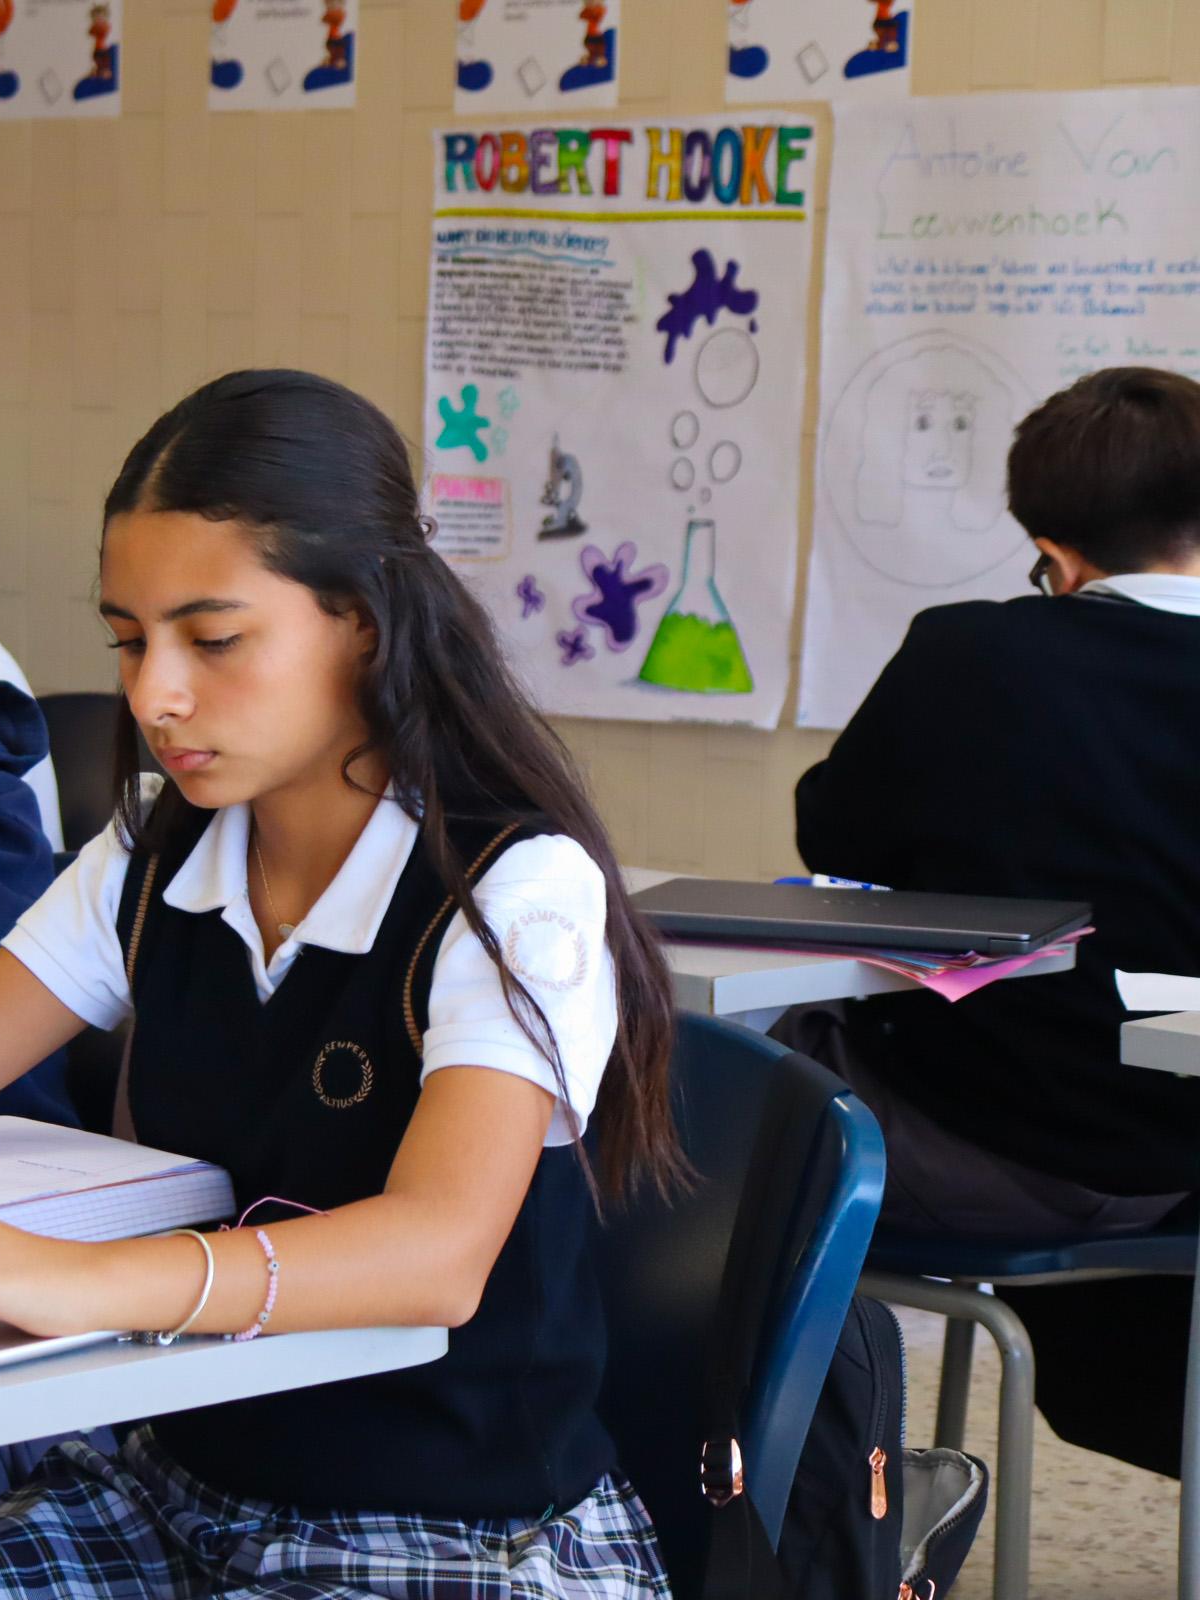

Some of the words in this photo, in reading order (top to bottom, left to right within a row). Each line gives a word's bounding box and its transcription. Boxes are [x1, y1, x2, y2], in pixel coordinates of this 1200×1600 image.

[443, 128, 633, 196] ROBERT
[646, 125, 813, 206] HOOKE
[1057, 113, 1180, 179] Van
[325, 1040, 367, 1061] SEMPER
